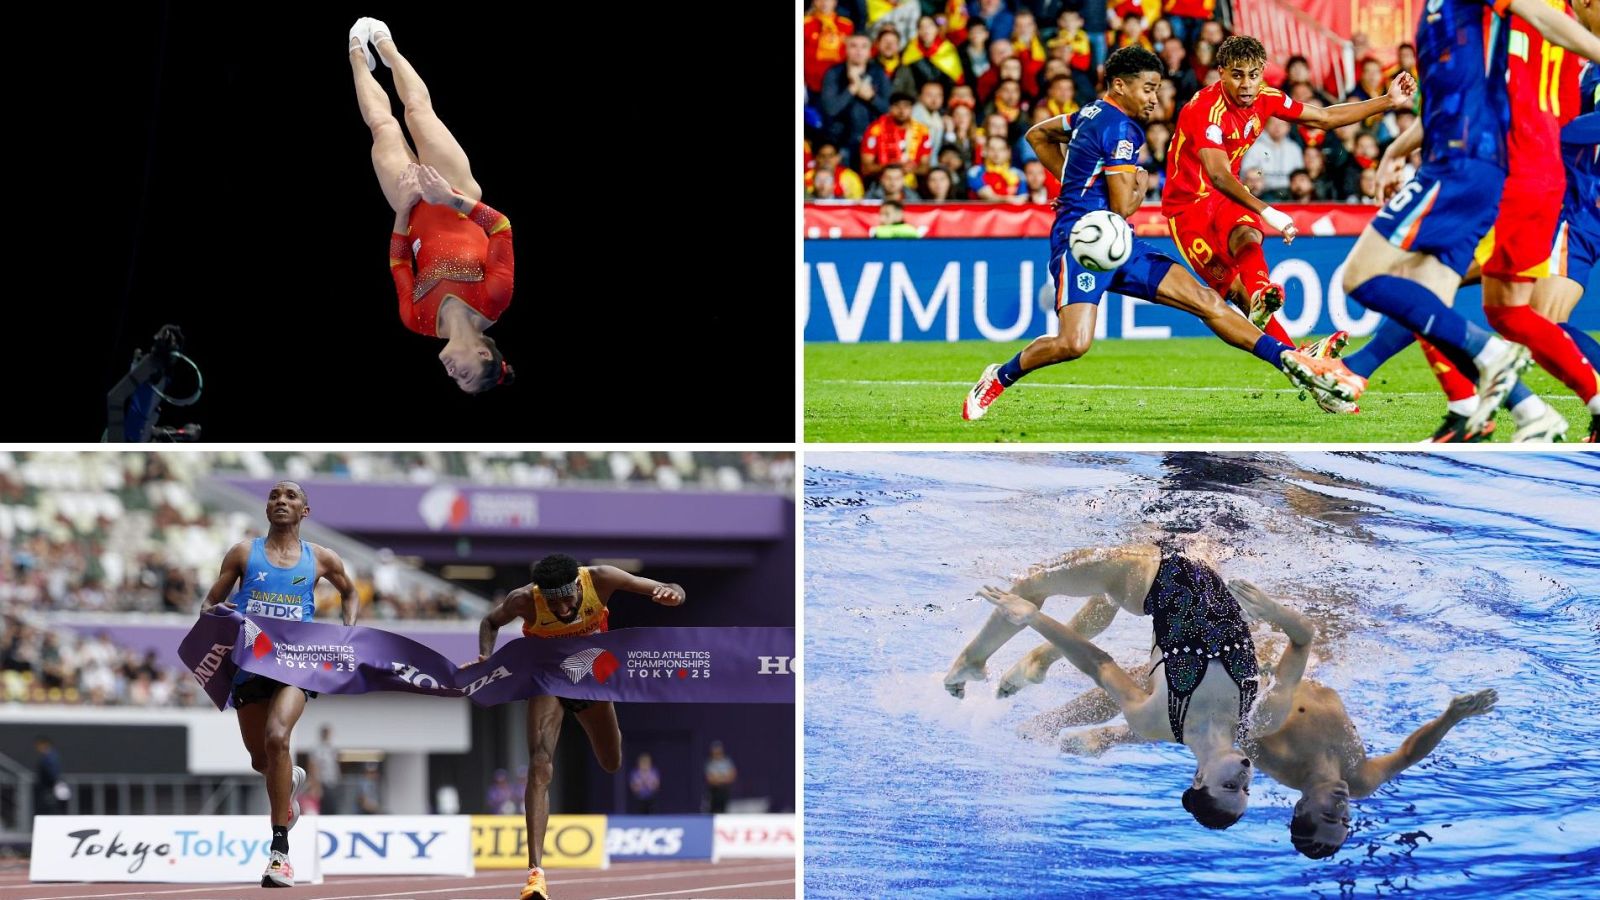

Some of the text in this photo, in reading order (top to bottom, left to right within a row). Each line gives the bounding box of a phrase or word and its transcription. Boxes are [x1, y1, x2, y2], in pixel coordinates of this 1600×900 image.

[1188, 238, 1213, 268] 19
[251, 590, 302, 604] TANZANIA
[262, 603, 299, 619] TDK
[273, 642, 355, 653] WORLD ATHLETICS
[276, 649, 355, 662] CHAMPIONSHIPS
[627, 651, 711, 659] WORLD ATHLETICS
[336, 663, 355, 672] 25
[627, 660, 710, 668] CHAMPIONSHIPS
[691, 669, 711, 678] 25
[67, 829, 170, 874] Tokyo
